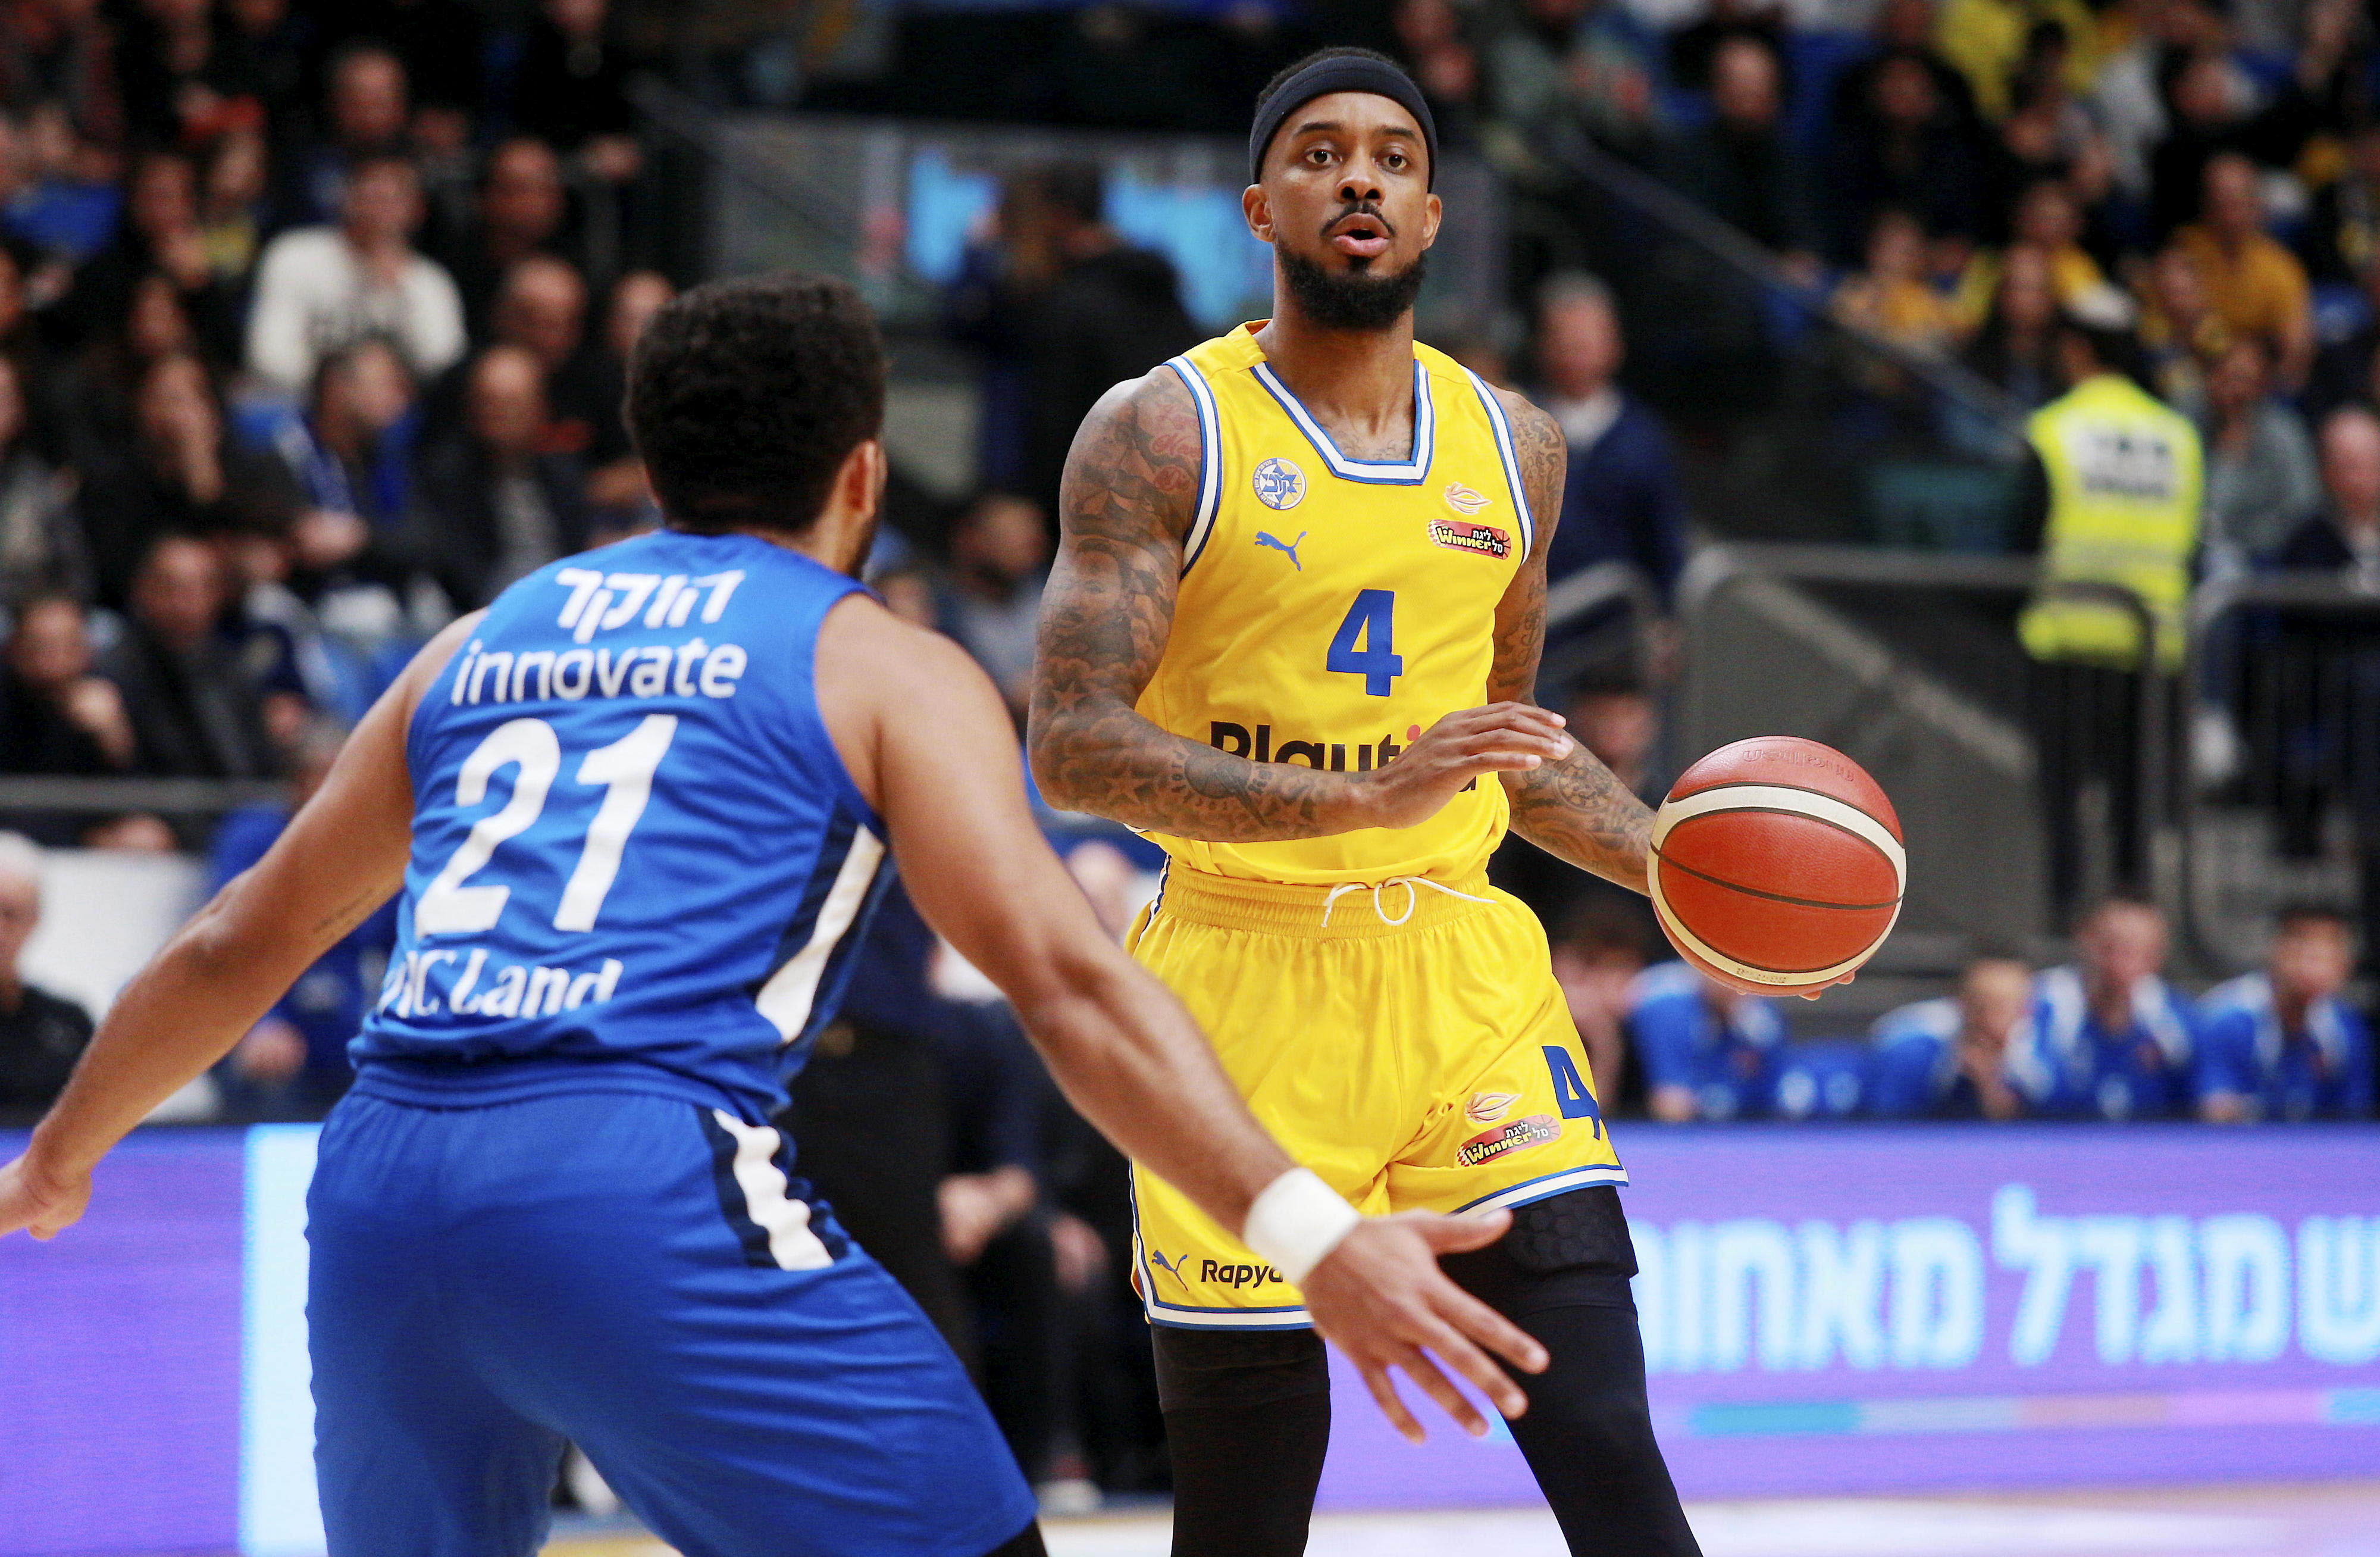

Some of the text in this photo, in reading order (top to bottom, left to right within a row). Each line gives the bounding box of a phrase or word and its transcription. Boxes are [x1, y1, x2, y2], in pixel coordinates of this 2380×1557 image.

[1436, 527, 1491, 550] Winner
[555, 567, 746, 644] הוקר
[450, 637, 747, 706] innovate
[1326, 589, 1402, 697] 4
[415, 714, 678, 939] 21
[449, 948, 624, 1020] Land
[1542, 1046, 1601, 1141] 4
[1465, 1132, 1532, 1163] Winner
